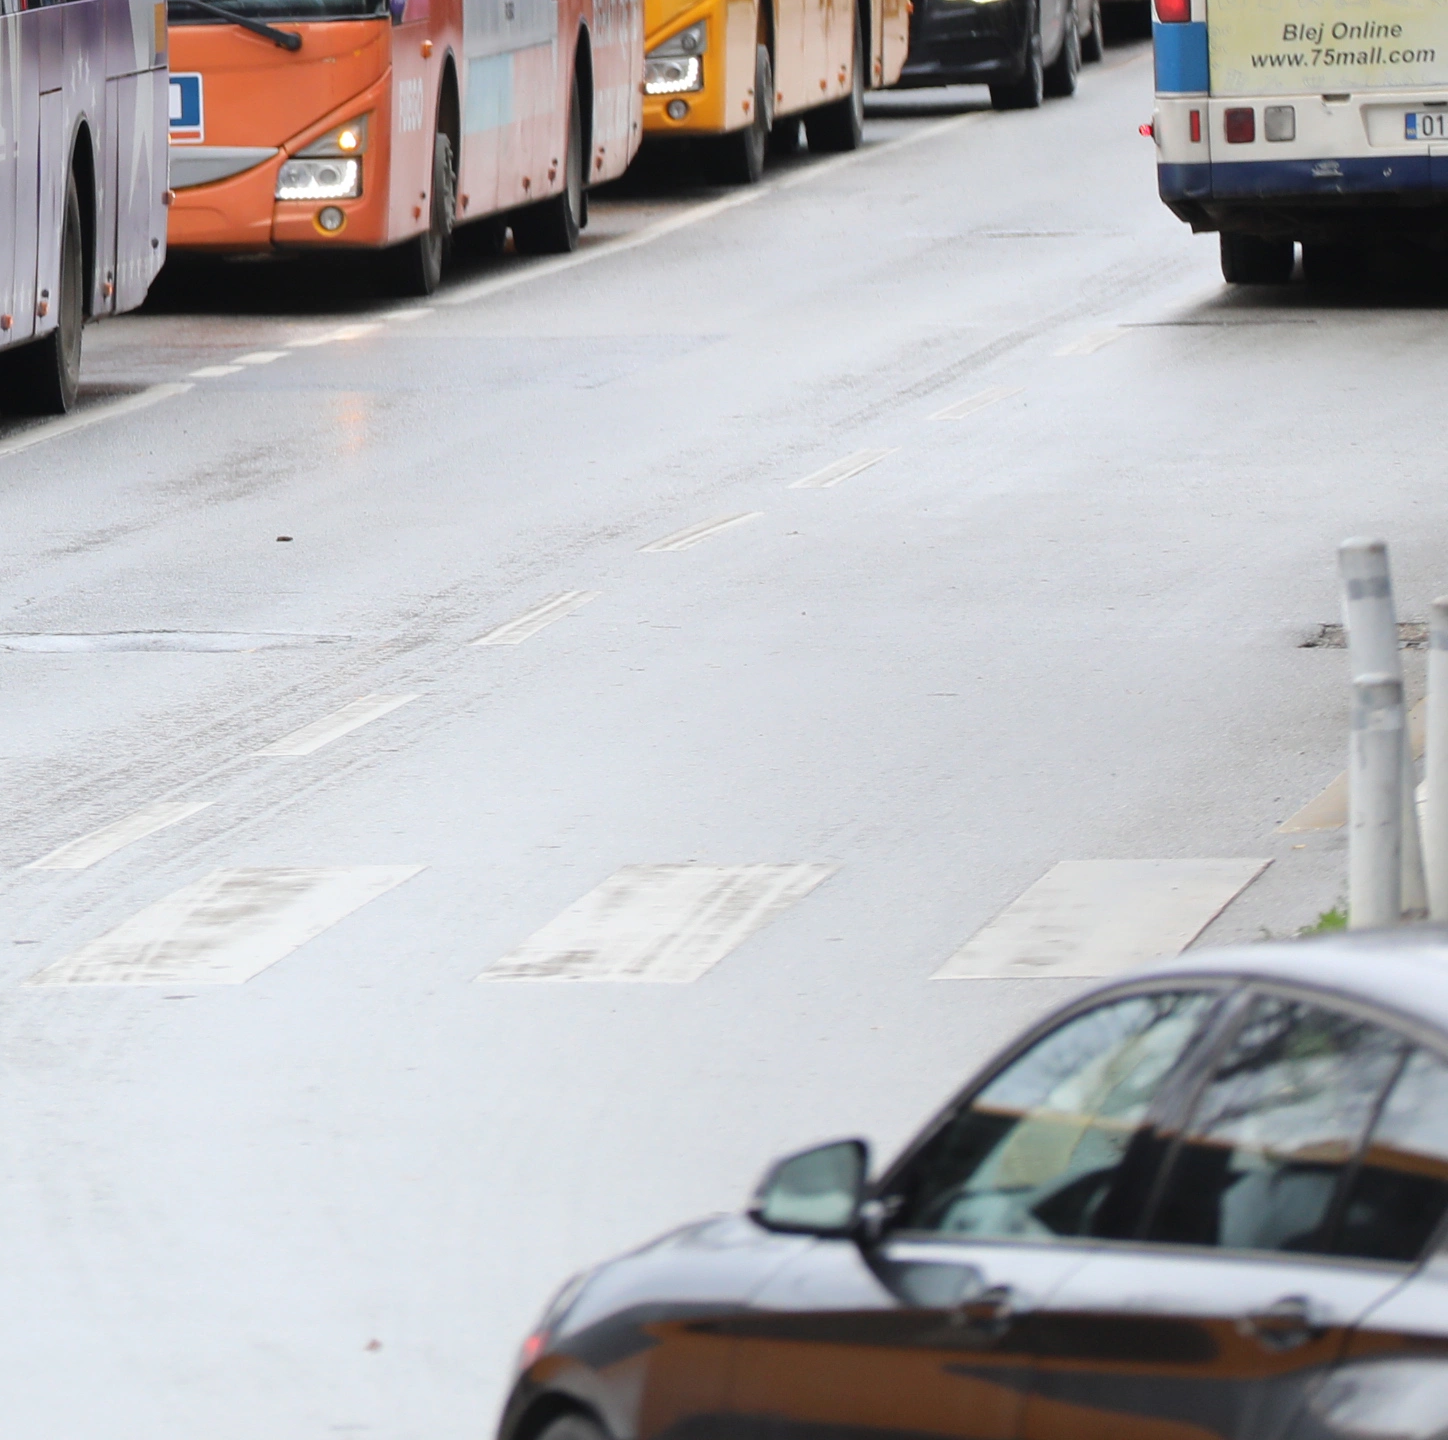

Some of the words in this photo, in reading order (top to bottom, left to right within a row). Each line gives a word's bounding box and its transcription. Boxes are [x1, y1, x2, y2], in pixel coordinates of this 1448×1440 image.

[1282, 23, 1325, 44] Blej
[1331, 21, 1403, 41] Online
[1251, 46, 1436, 68] www.75mall.com
[1422, 114, 1443, 137] 01
